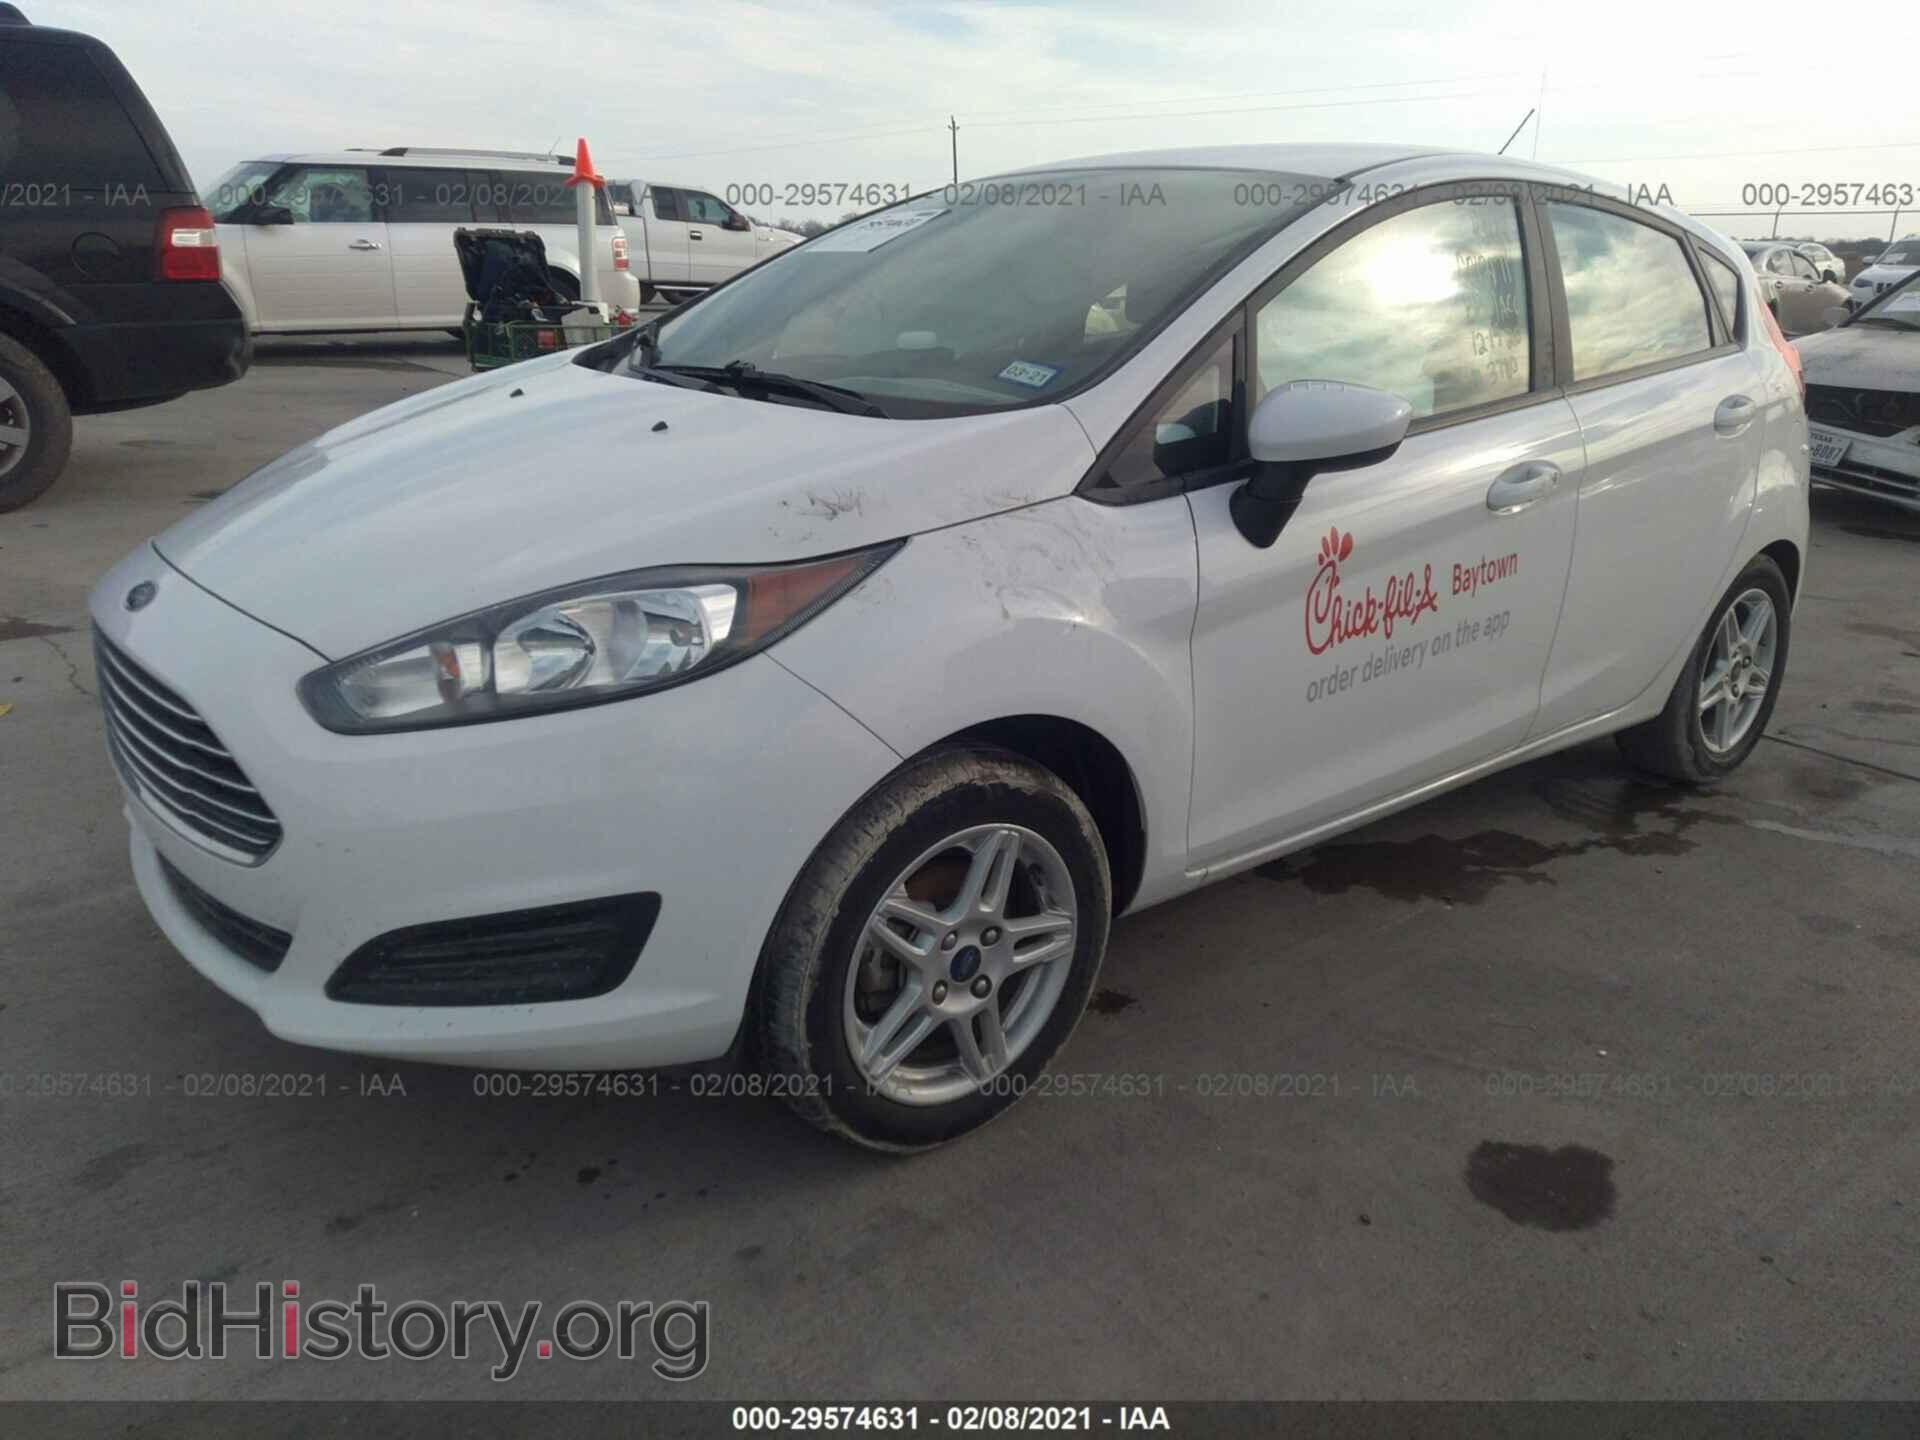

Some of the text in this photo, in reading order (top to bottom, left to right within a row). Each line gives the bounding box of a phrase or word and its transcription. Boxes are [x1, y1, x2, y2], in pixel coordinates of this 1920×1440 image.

[1452, 552, 1518, 597] Baytown
[1306, 609, 1511, 703] order delivery on the app
